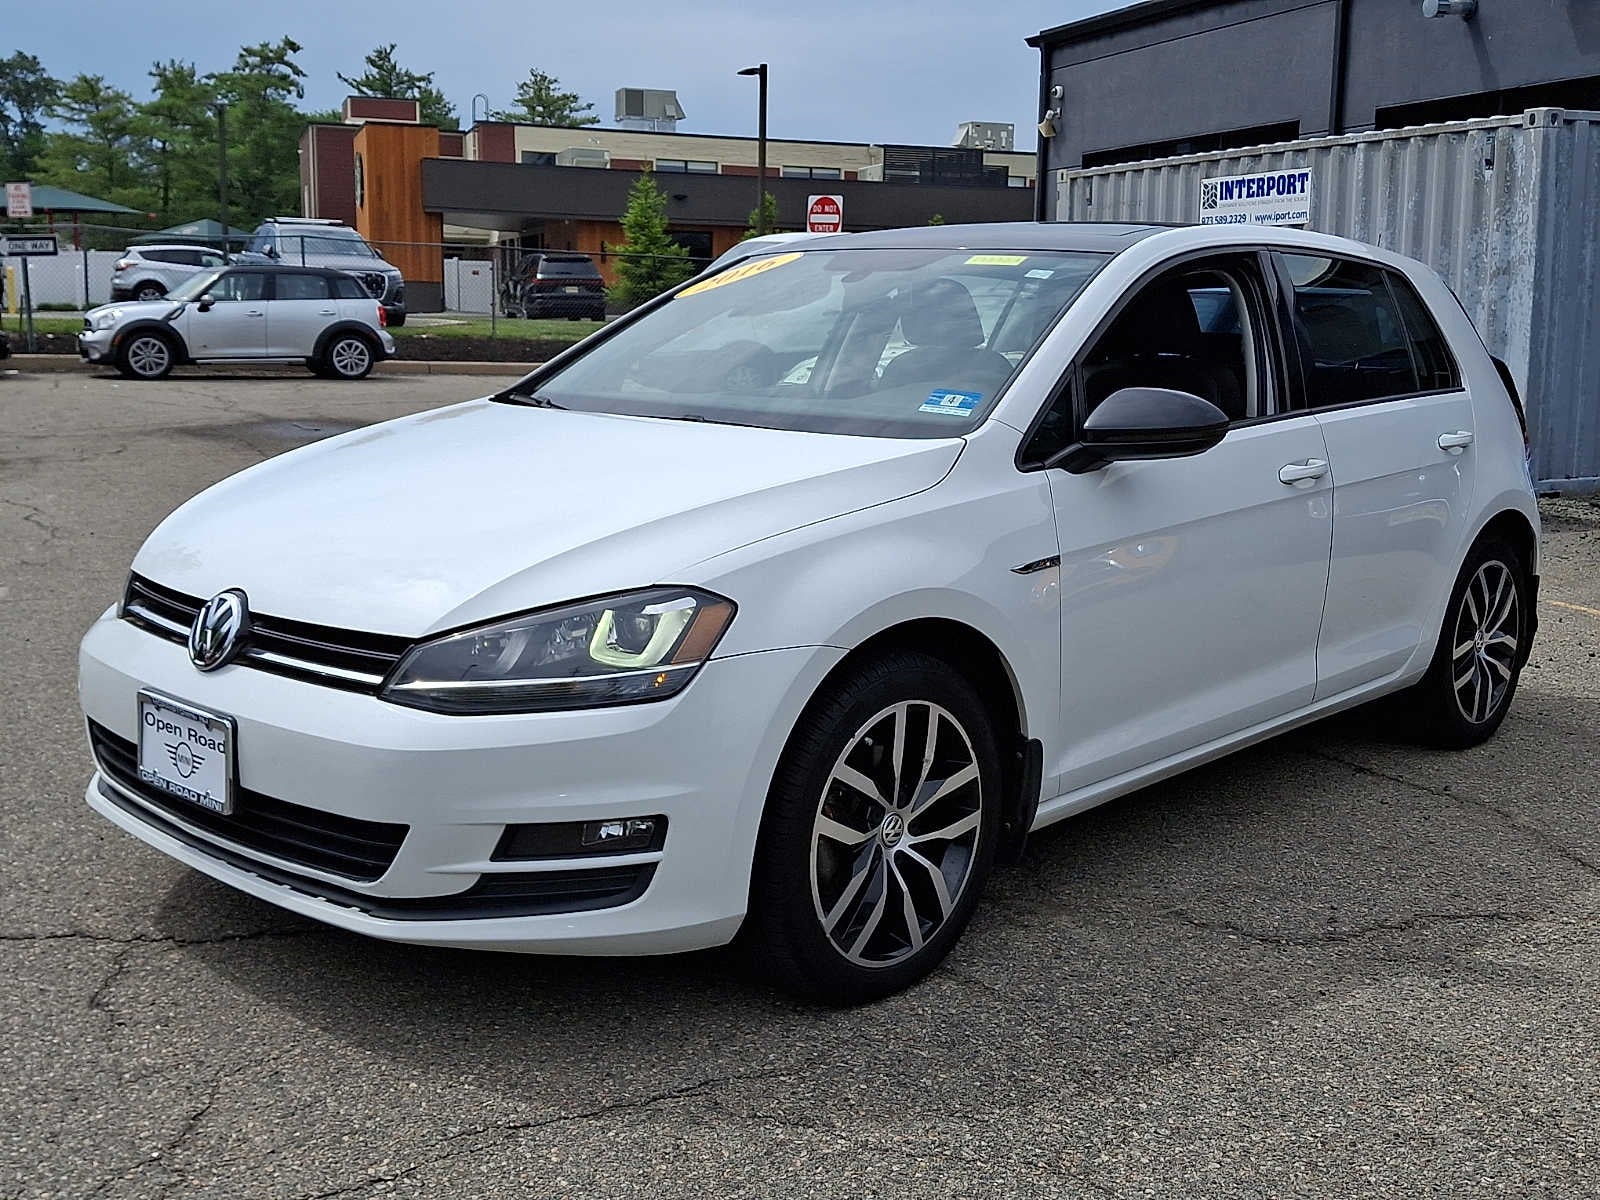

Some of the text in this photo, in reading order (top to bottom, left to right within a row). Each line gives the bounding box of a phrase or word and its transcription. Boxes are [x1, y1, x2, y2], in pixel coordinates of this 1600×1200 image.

[1219, 172, 1309, 201] INTERPORT
[812, 204, 837, 213] DO NOT
[1255, 210, 1308, 223] www.iport.com
[814, 224, 834, 232] ENTER
[31, 240, 49, 250] WAY
[144, 711, 226, 754] Open Road
[141, 770, 224, 813] OPEN ROAD MINI
